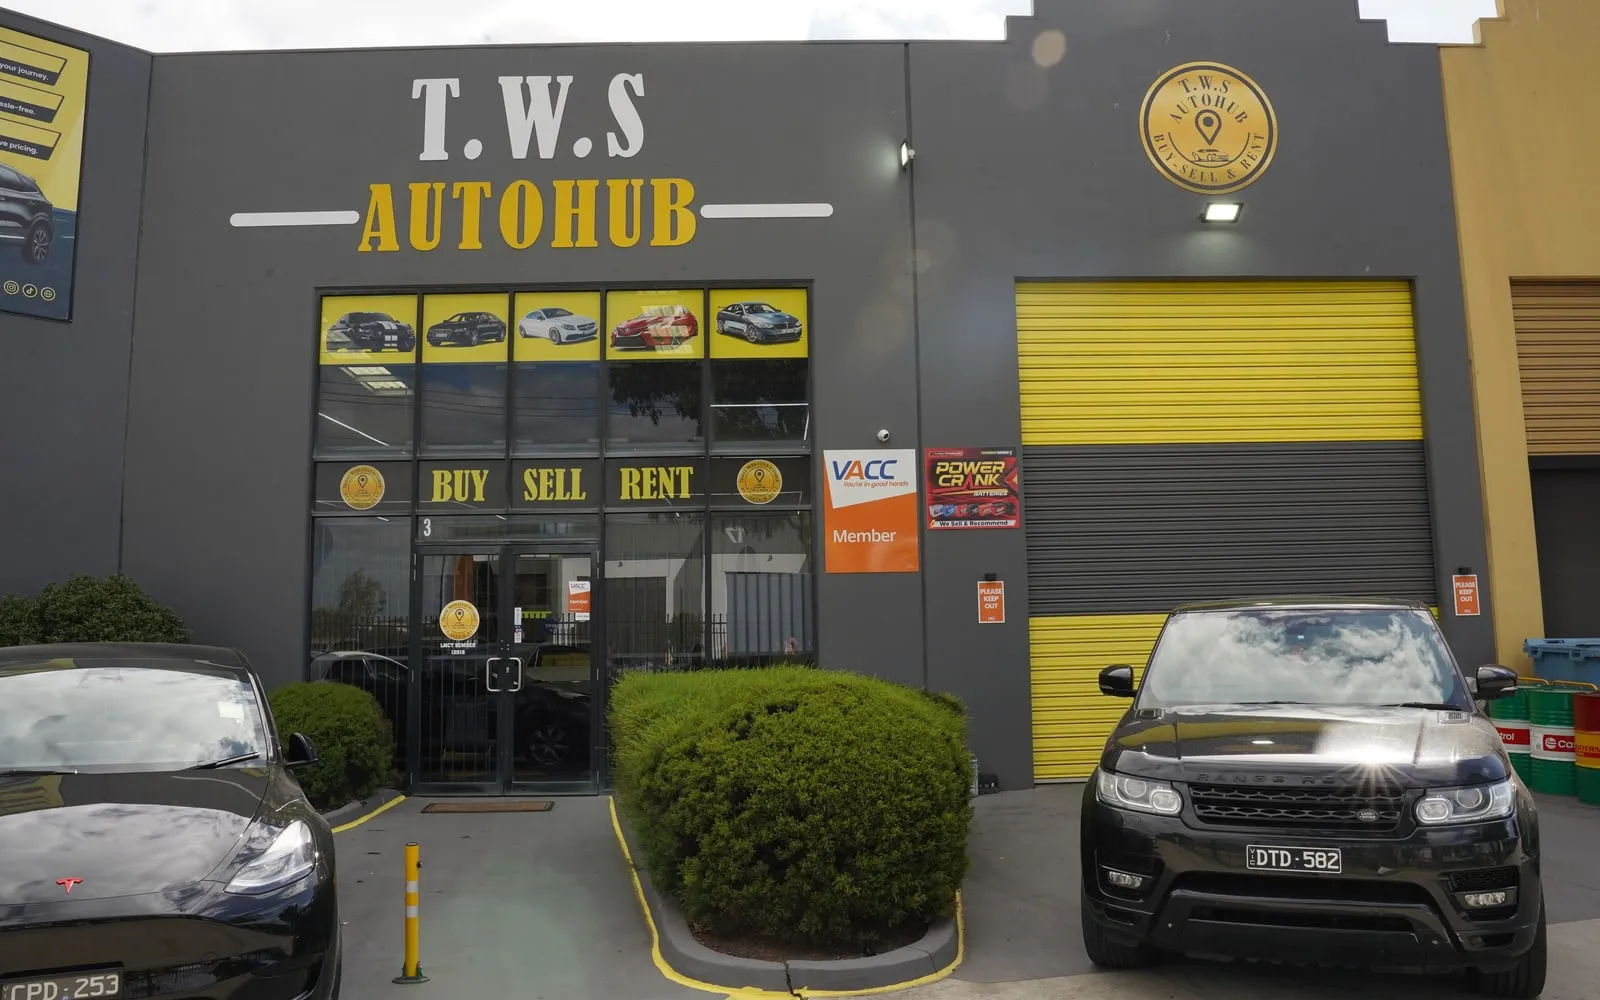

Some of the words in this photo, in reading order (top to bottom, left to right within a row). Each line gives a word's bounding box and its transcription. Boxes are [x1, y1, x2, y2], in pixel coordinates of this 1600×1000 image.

[17, 66, 49, 80] journey.
[1178, 75, 1231, 94] T.W.S
[0, 101, 36, 115] ssle-free.
[1169, 93, 1248, 124] AUTOHUB
[411, 73, 645, 161] T.W.S
[9, 143, 39, 155] pricing.
[358, 178, 697, 252] AUTOHUB
[832, 460, 898, 480] VACC
[935, 461, 1006, 475] POWER
[431, 469, 489, 502] BUY
[523, 467, 587, 501] SELL
[619, 466, 694, 500] RENT
[843, 480, 863, 488] You're
[864, 480, 870, 488] in
[870, 481, 888, 489] good
[423, 518, 432, 537] 3
[833, 528, 897, 544] Member
[1500, 732, 1515, 741] trol
[1558, 739, 1576, 749] Ca
[1198, 773, 1285, 783] RANGE
